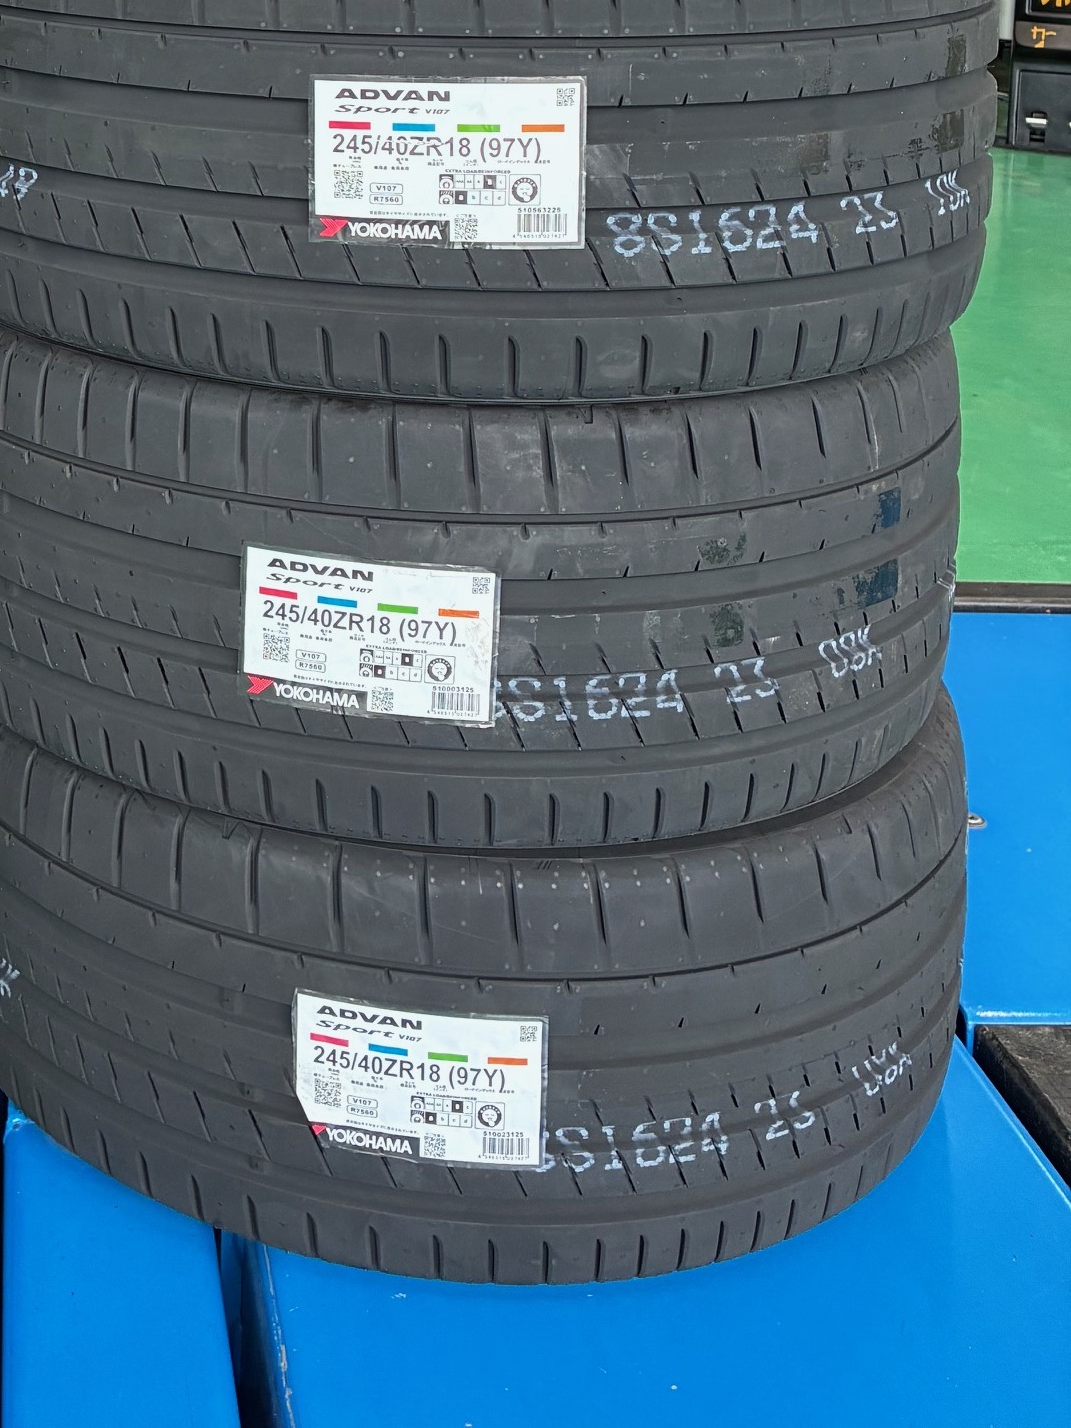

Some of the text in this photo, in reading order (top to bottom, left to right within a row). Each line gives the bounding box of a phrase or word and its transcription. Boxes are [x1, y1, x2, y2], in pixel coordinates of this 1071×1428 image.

[335, 88, 450, 102] ADVAN
[334, 104, 421, 115] Sport
[332, 134, 541, 163] 245/40ZR18 (97Y)
[348, 222, 442, 241] YOKOHAMA
[267, 559, 373, 582] ADVAN
[266, 573, 372, 594] Sport V107
[263, 600, 457, 645] 245/40ZR18 (97Y)
[302, 652, 320, 660] V107
[273, 682, 360, 709] YOKOHAMA
[316, 1005, 422, 1031] ADVAN
[316, 1020, 422, 1043] Sport V107
[313, 1045, 505, 1091] 245/40ZR18 (97Y)
[353, 1098, 372, 1106] V107
[326, 1128, 413, 1155] YOKOHAMA
